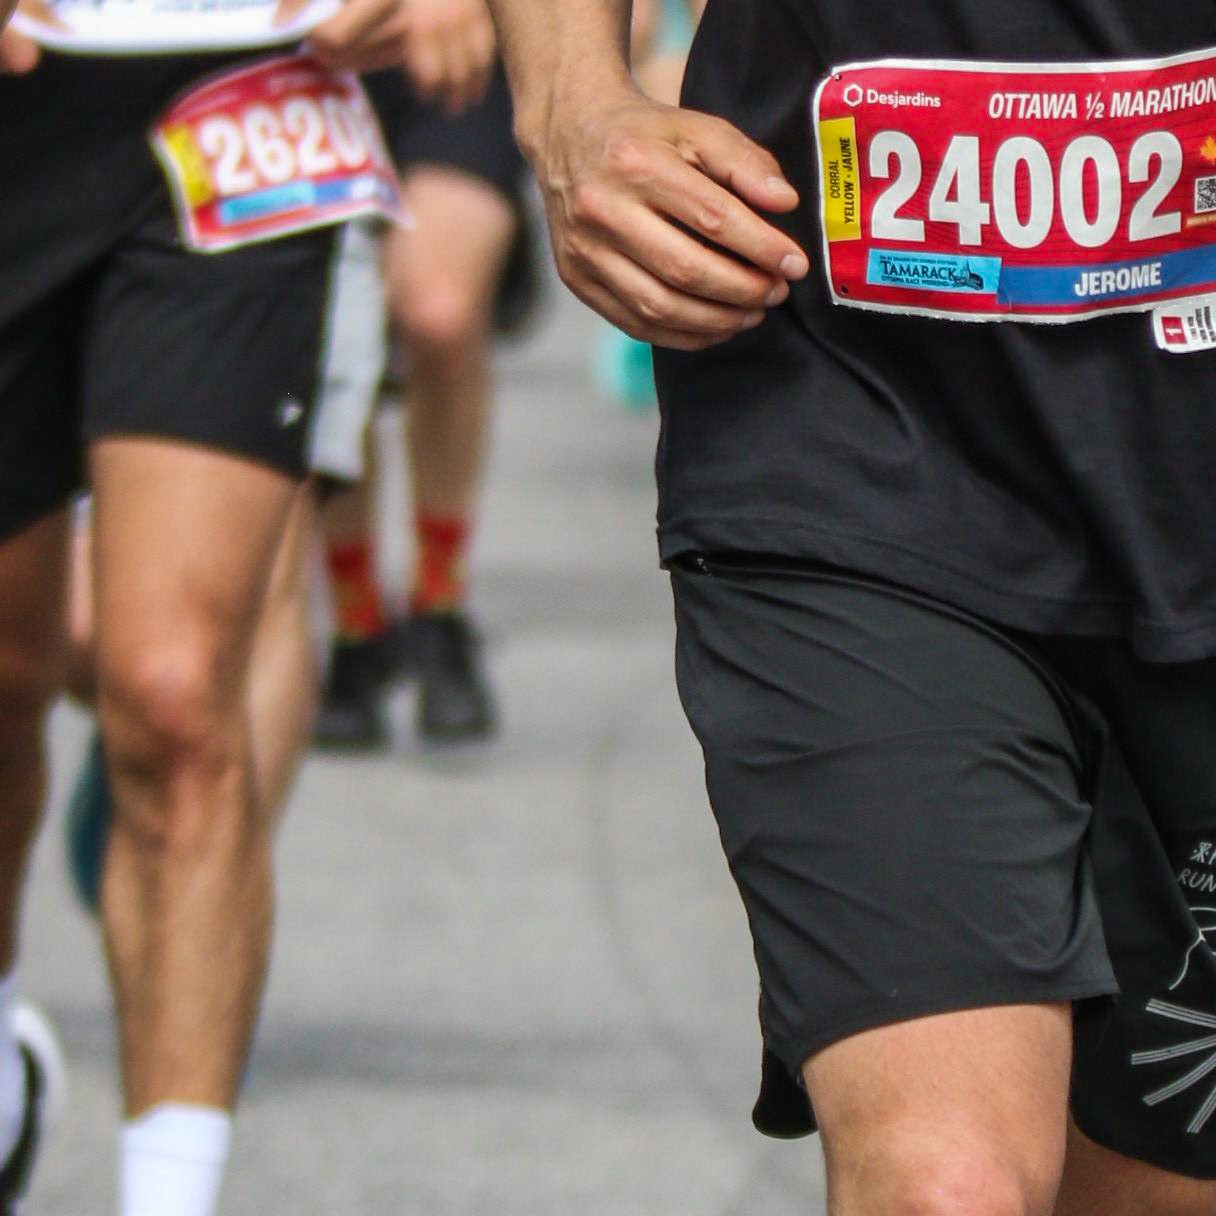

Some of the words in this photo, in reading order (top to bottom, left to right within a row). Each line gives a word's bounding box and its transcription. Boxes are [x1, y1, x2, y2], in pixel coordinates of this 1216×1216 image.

[866, 88, 942, 108] Desjardins
[988, 92, 1078, 119] OTTAWA
[840, 136, 853, 171] JAUNE
[828, 159, 841, 199] CORRAL
[869, 130, 1184, 249] 24002
[844, 182, 855, 224] YELLOW
[880, 260, 958, 283] TAMARACK
[1074, 262, 1162, 296] JEROME
